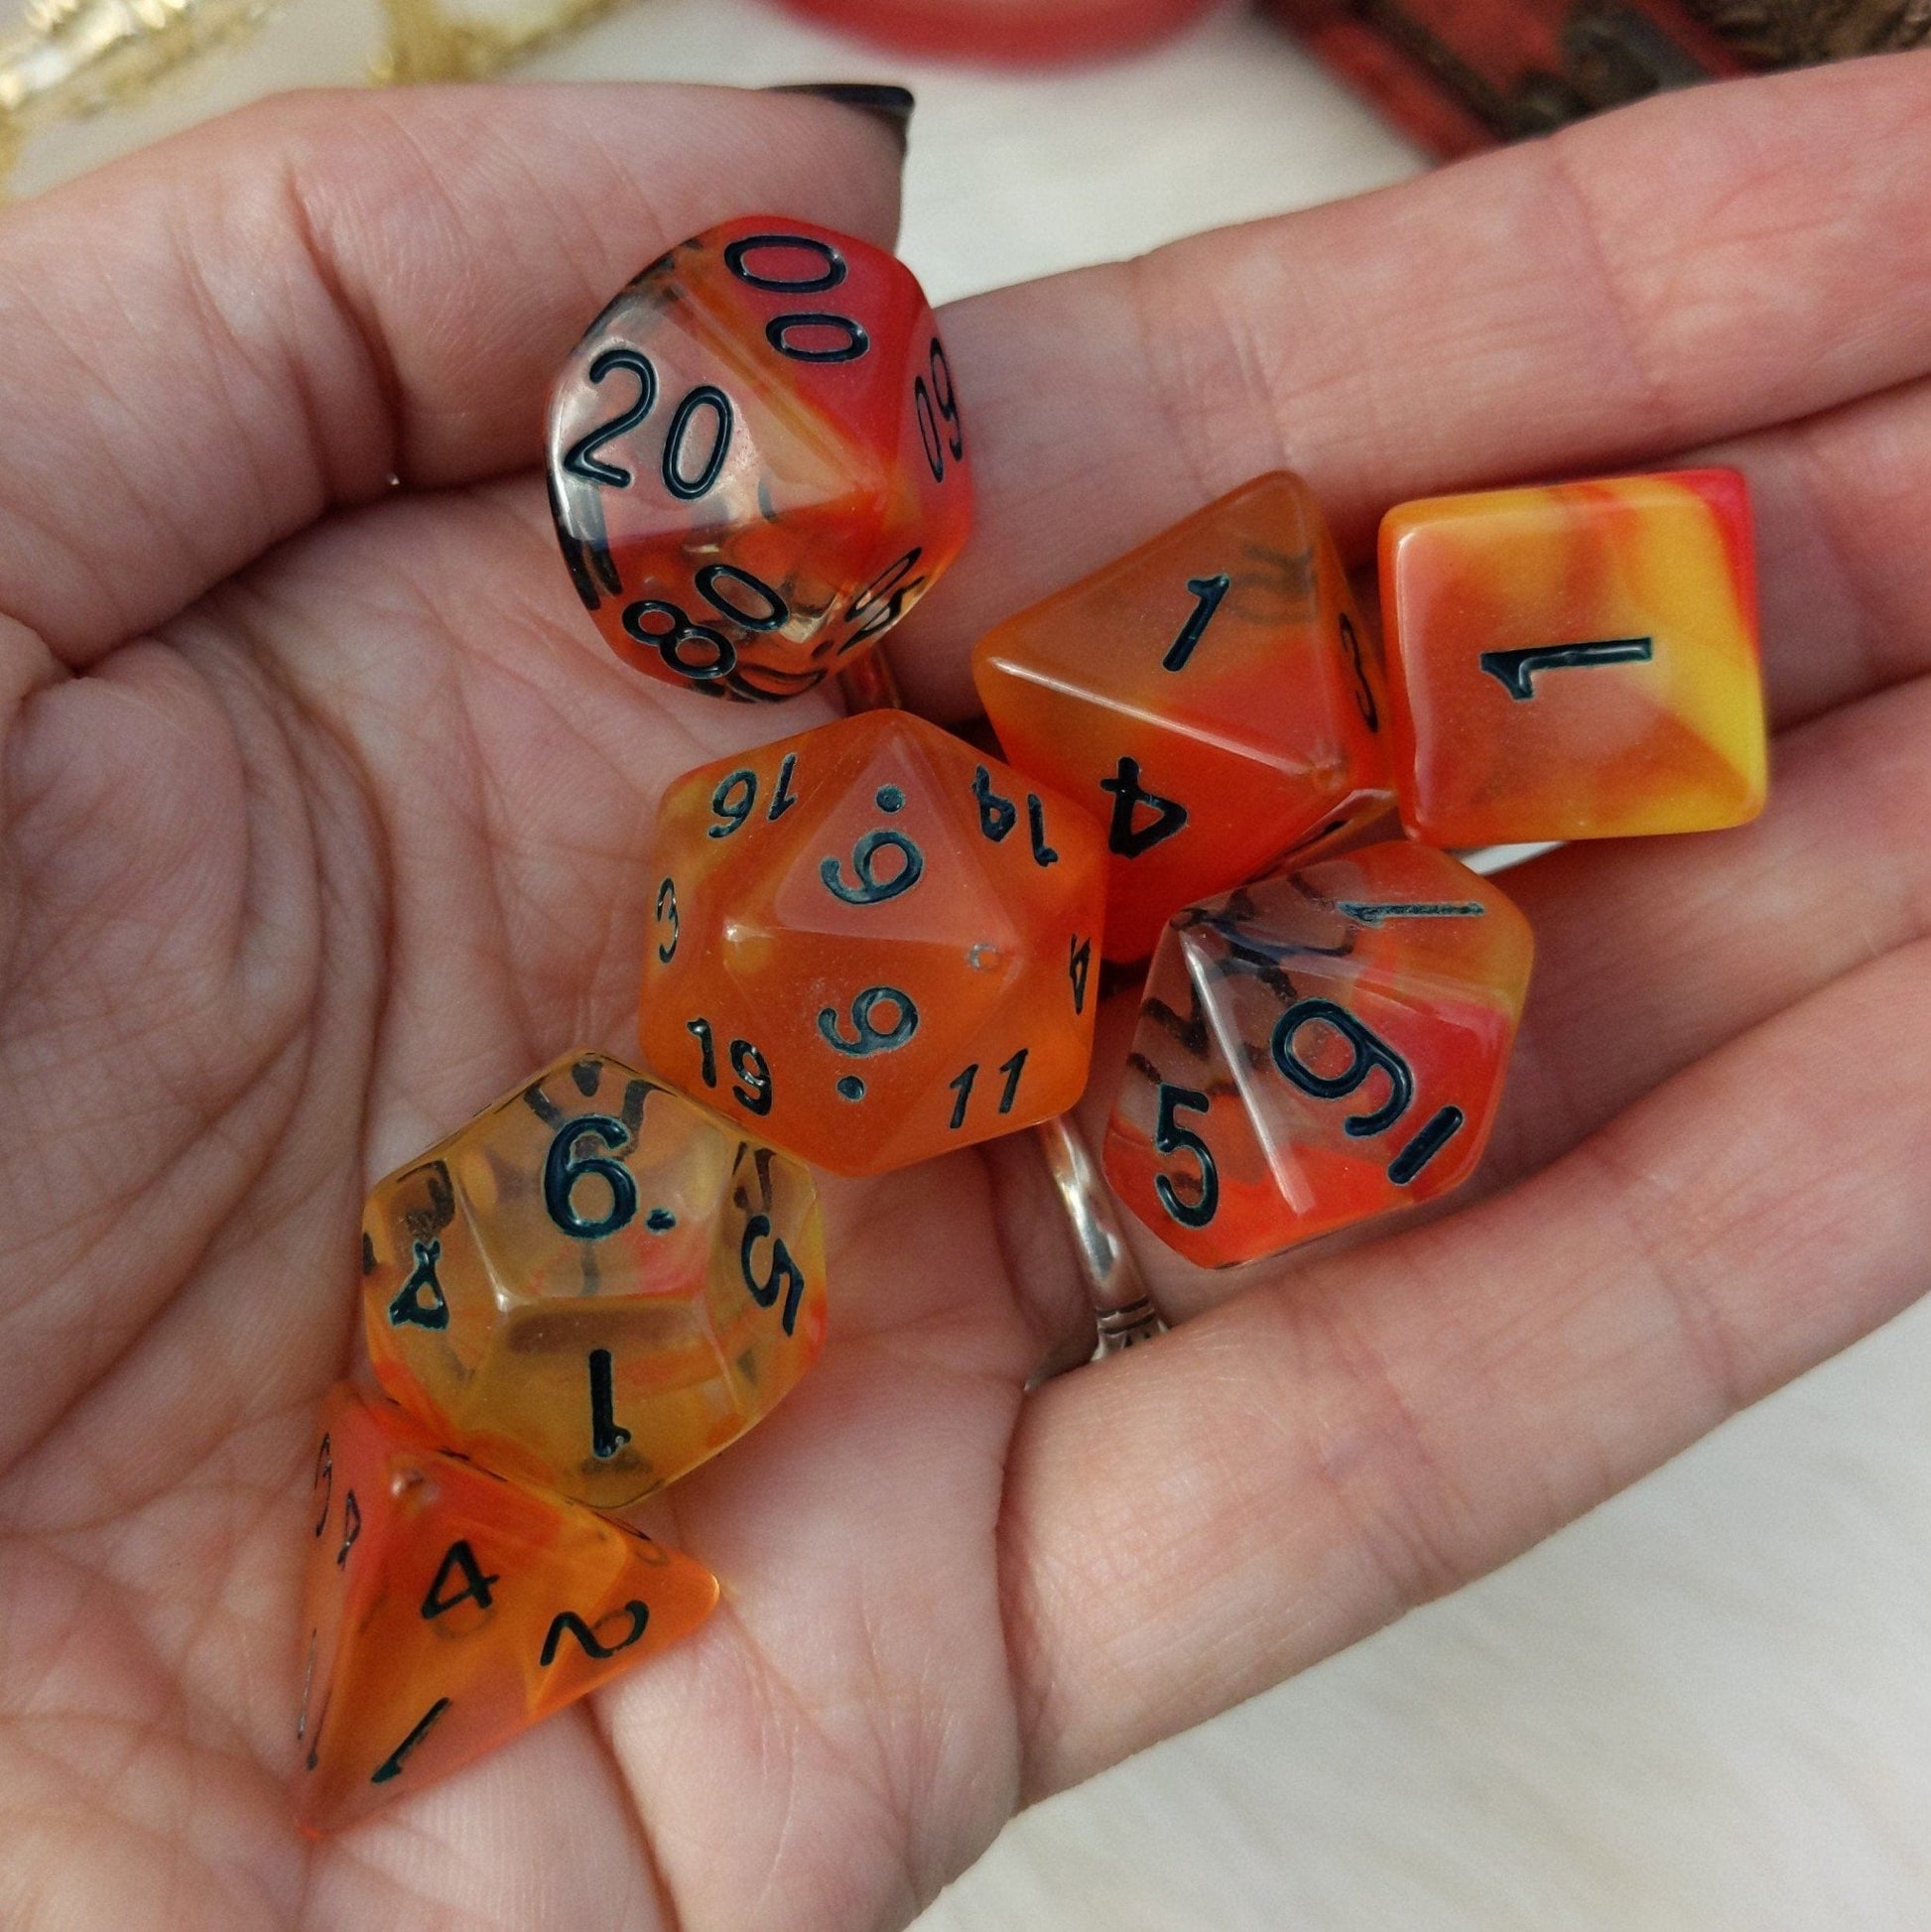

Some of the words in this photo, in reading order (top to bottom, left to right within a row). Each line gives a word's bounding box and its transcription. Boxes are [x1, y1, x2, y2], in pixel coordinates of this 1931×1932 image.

[724, 235, 869, 363] 00
[564, 348, 733, 500] 20
[621, 563, 790, 680] 80
[1163, 574, 1230, 672] 1
[1479, 636, 1652, 701] 1
[1099, 755, 1188, 859] 4
[1337, 901, 1485, 927] 1
[687, 1017, 773, 1116] 19
[949, 1047, 1029, 1129] 11
[1155, 1084, 1219, 1227] 5
[740, 1215, 805, 1338] 5
[587, 1348, 631, 1459] 1
[421, 1540, 499, 1619] 4
[540, 1600, 649, 1666] 2
[371, 1697, 452, 1784] 1
